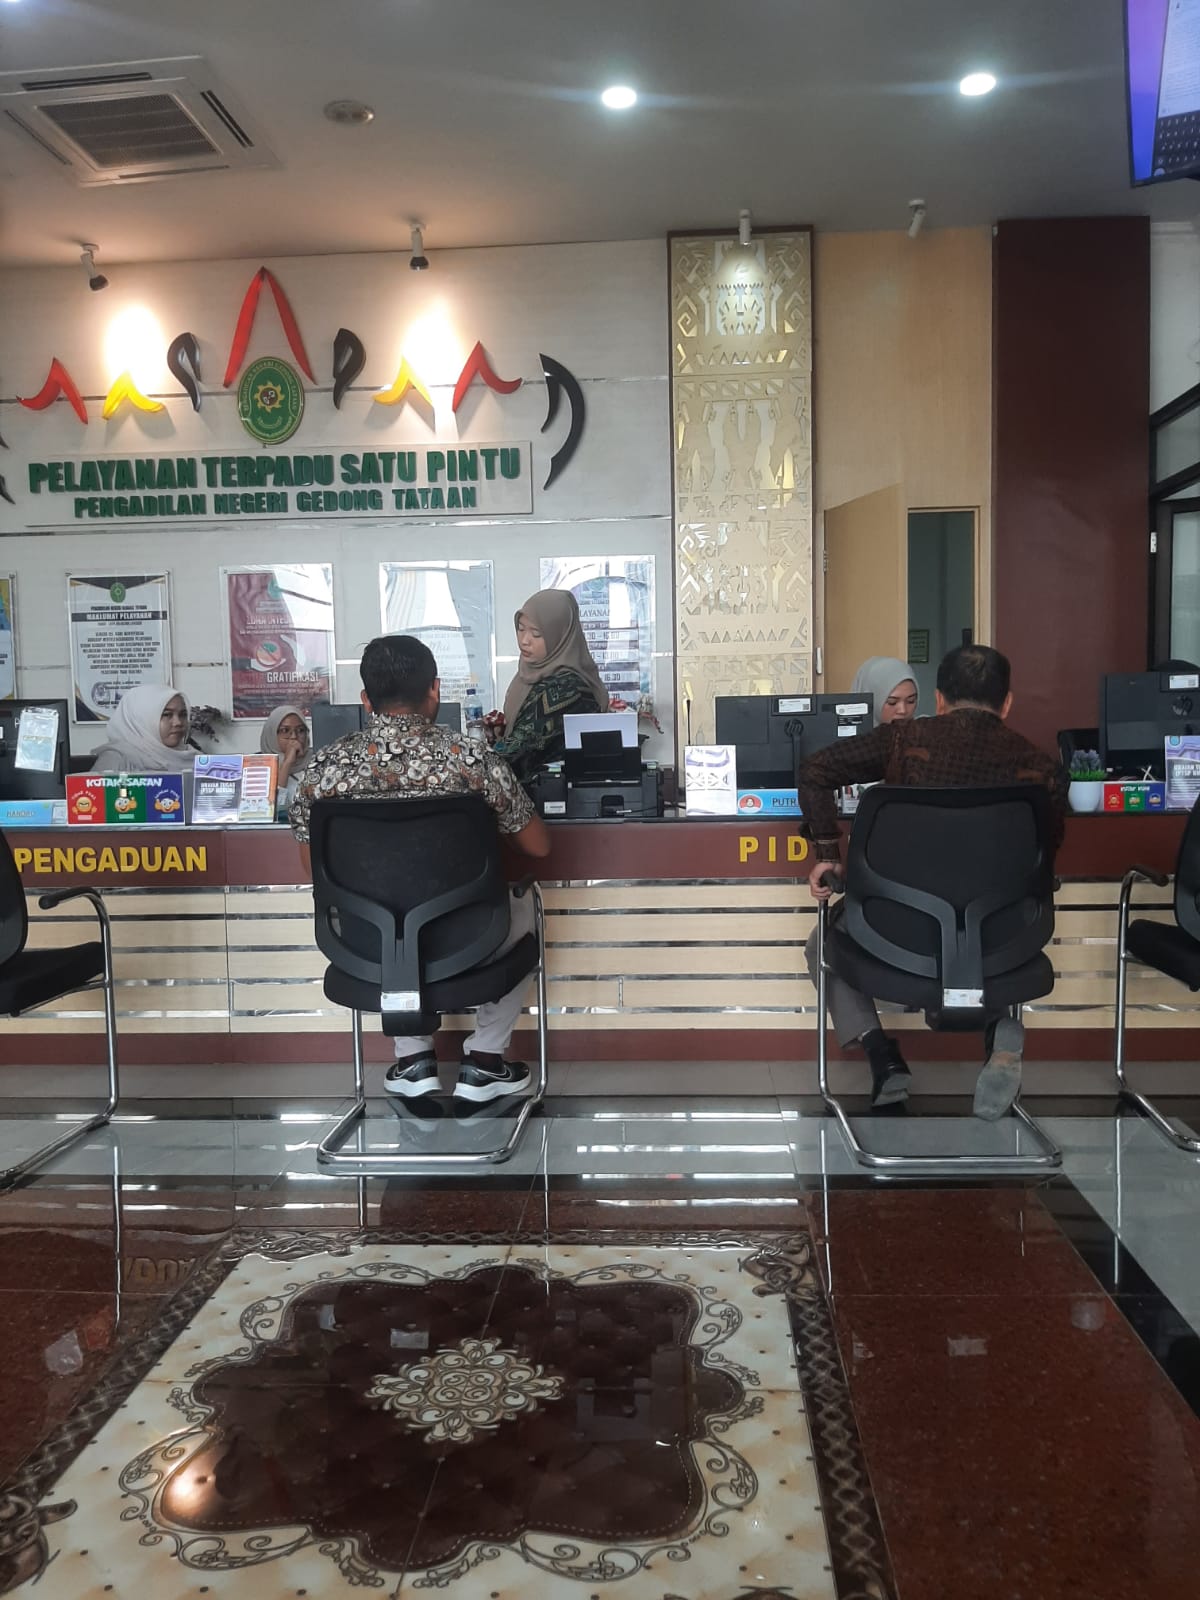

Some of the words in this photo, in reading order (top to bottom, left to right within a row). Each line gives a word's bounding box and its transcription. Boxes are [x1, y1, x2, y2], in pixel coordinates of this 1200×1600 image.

[28, 457, 197, 494] PELAYANAN
[201, 455, 335, 487] TERPADU
[340, 451, 417, 485] SATU
[427, 448, 521, 482] PINTU
[74, 493, 207, 518] PENGADILAN
[214, 491, 289, 514] NEGERI
[296, 489, 383, 512] GEDONG
[392, 487, 477, 510] TATAAN
[86, 612, 119, 621] MAKLUMAT
[120, 611, 152, 620] PELAYANAN
[580, 608, 609, 618] LAYANA
[266, 671, 319, 683] GRATIFIKASI
[85, 778, 120, 788] KOTAK
[126, 777, 163, 787] SARAN
[739, 835, 809, 863] PID
[13, 846, 208, 873] PENGADUAN
